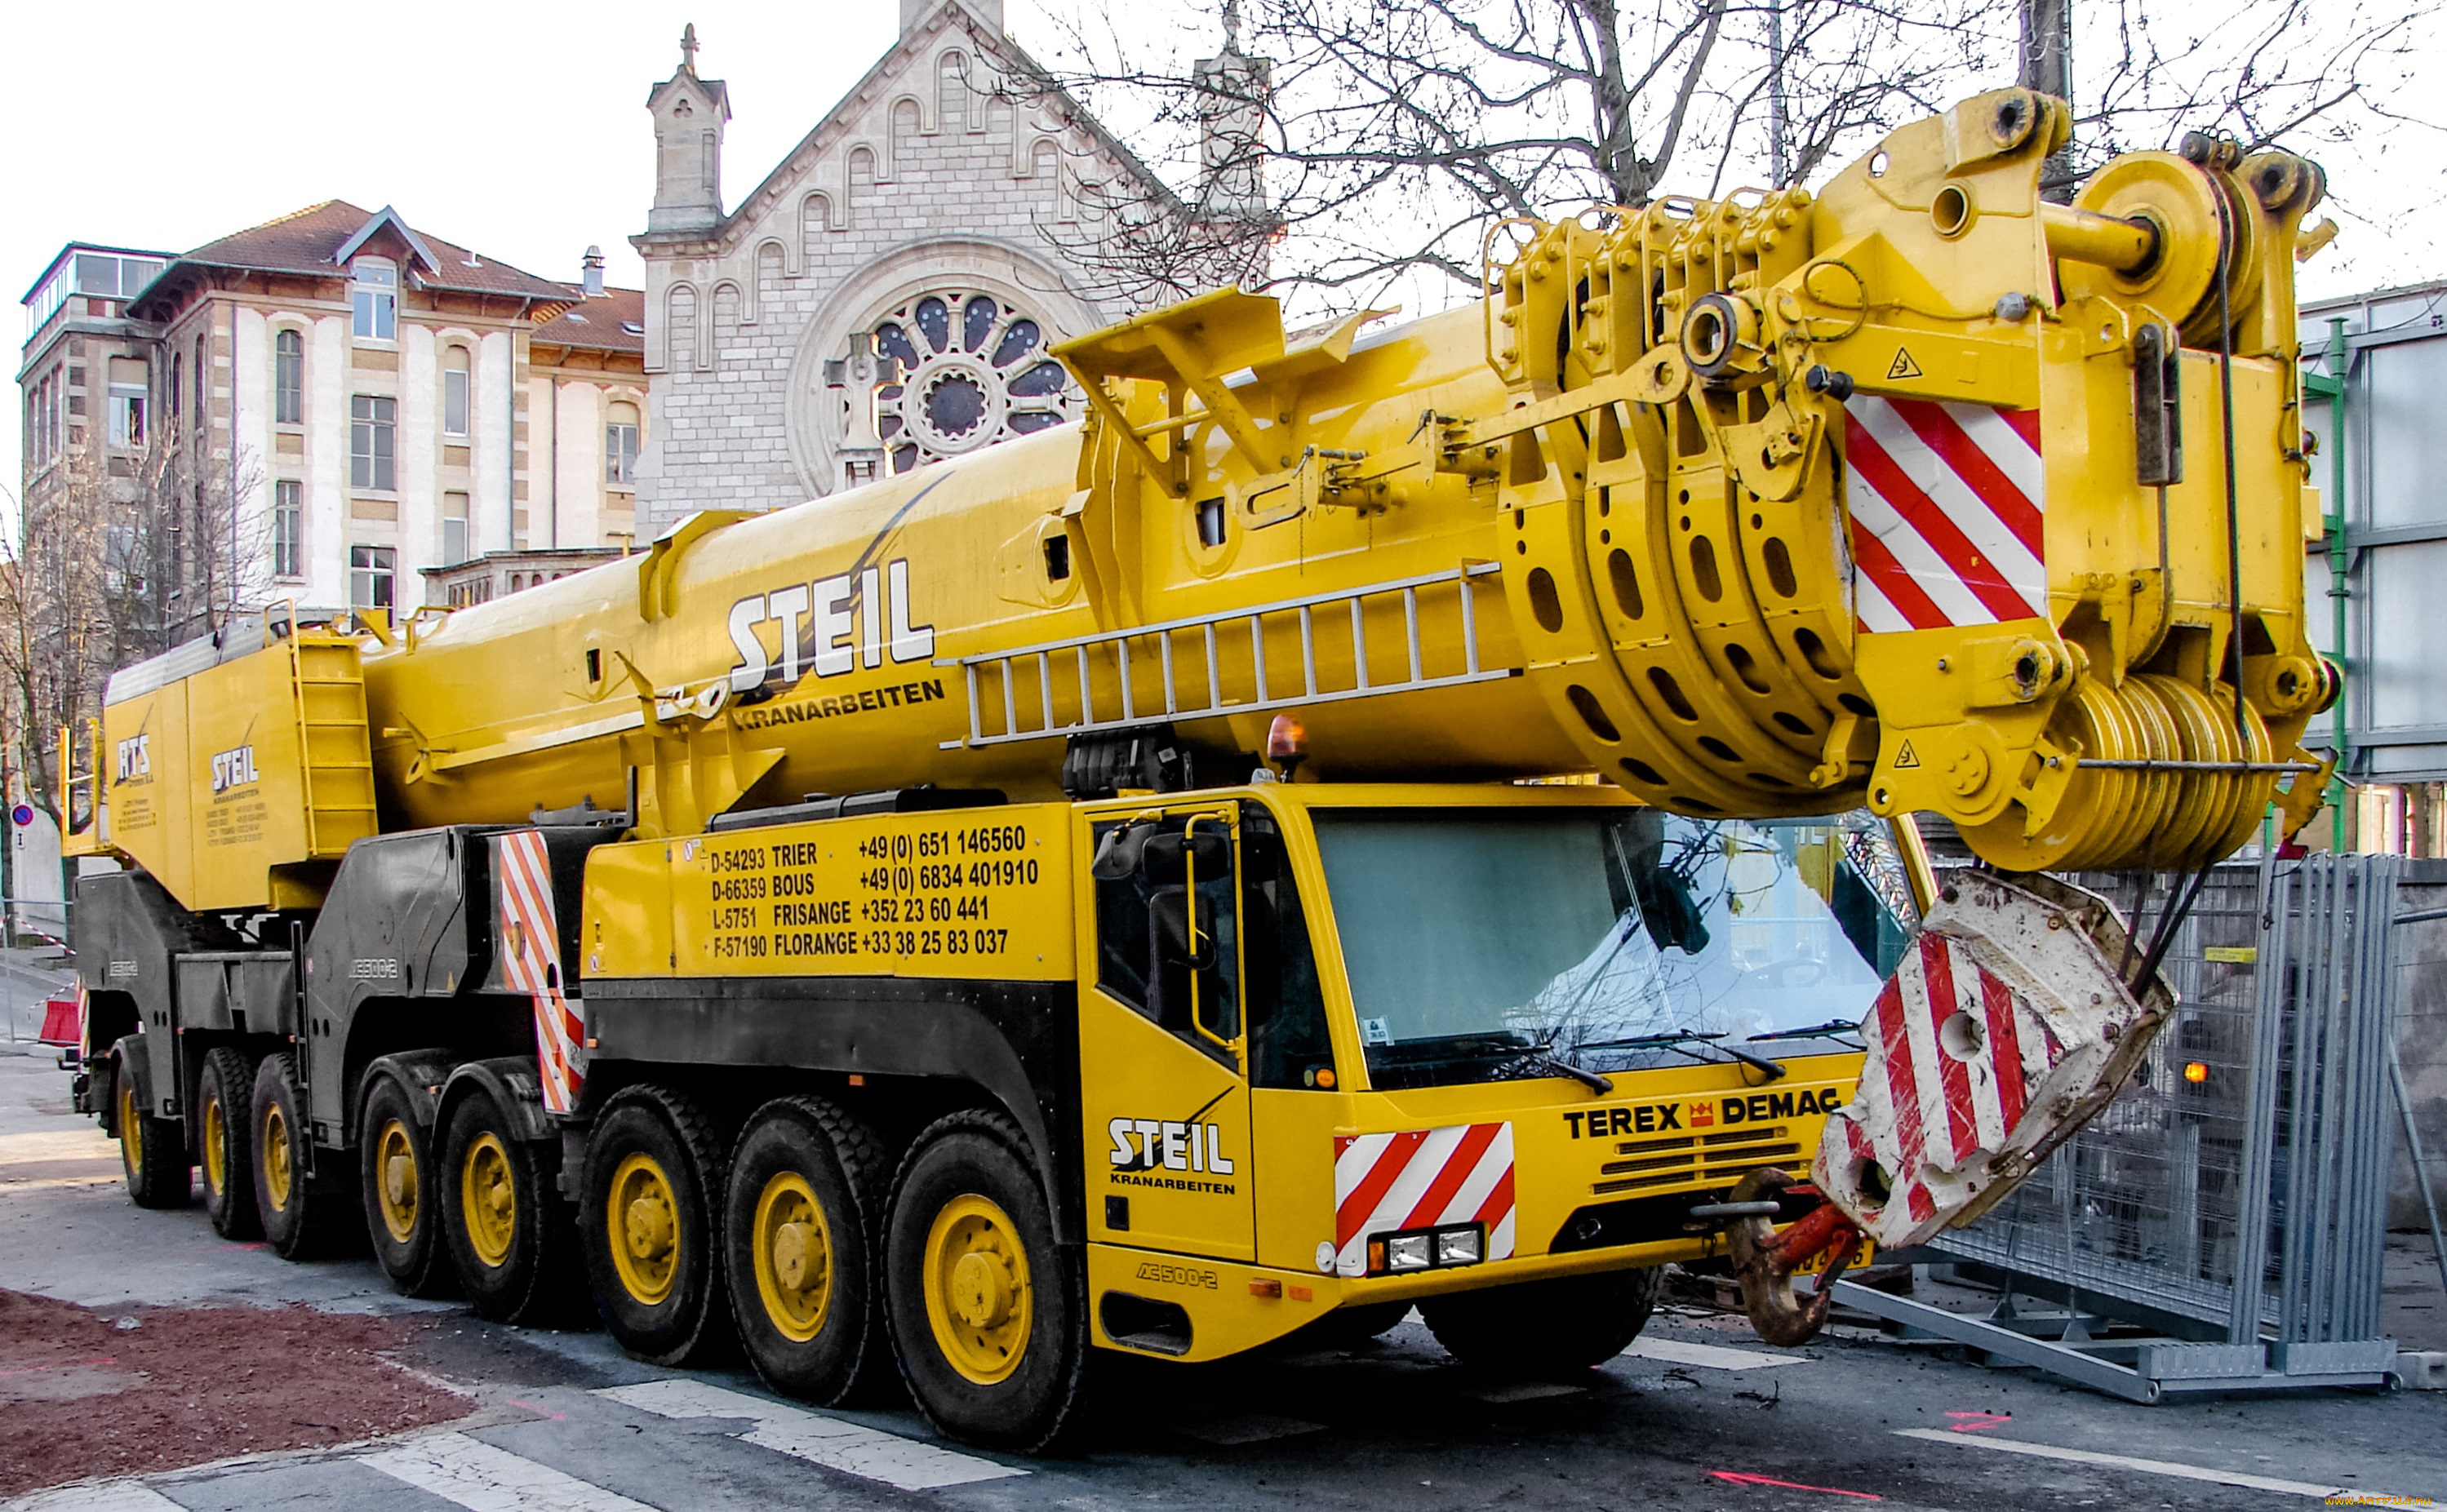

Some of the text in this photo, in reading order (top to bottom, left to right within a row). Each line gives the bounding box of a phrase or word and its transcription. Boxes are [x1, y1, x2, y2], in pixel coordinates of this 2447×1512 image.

[729, 559, 935, 694] STEIL
[732, 679, 944, 732] KRANARBEITEN
[211, 745, 260, 791] STEIL
[712, 825, 1025, 873] D-54293 TRIER +49 (0) 651 146560
[713, 858, 1038, 902] D-66359 BOUS +49 (0) 6834 401910
[713, 895, 988, 929] L-5751 FRISANGE +352 23 60 441
[714, 929, 1008, 958] F-57190 FLORANGE +33 38 25 83 037
[1563, 1088, 1841, 1139] TEREX DEMAG
[1108, 1117, 1234, 1175] STEIL
[1110, 1173, 1235, 1195] KRANARBEITEN
